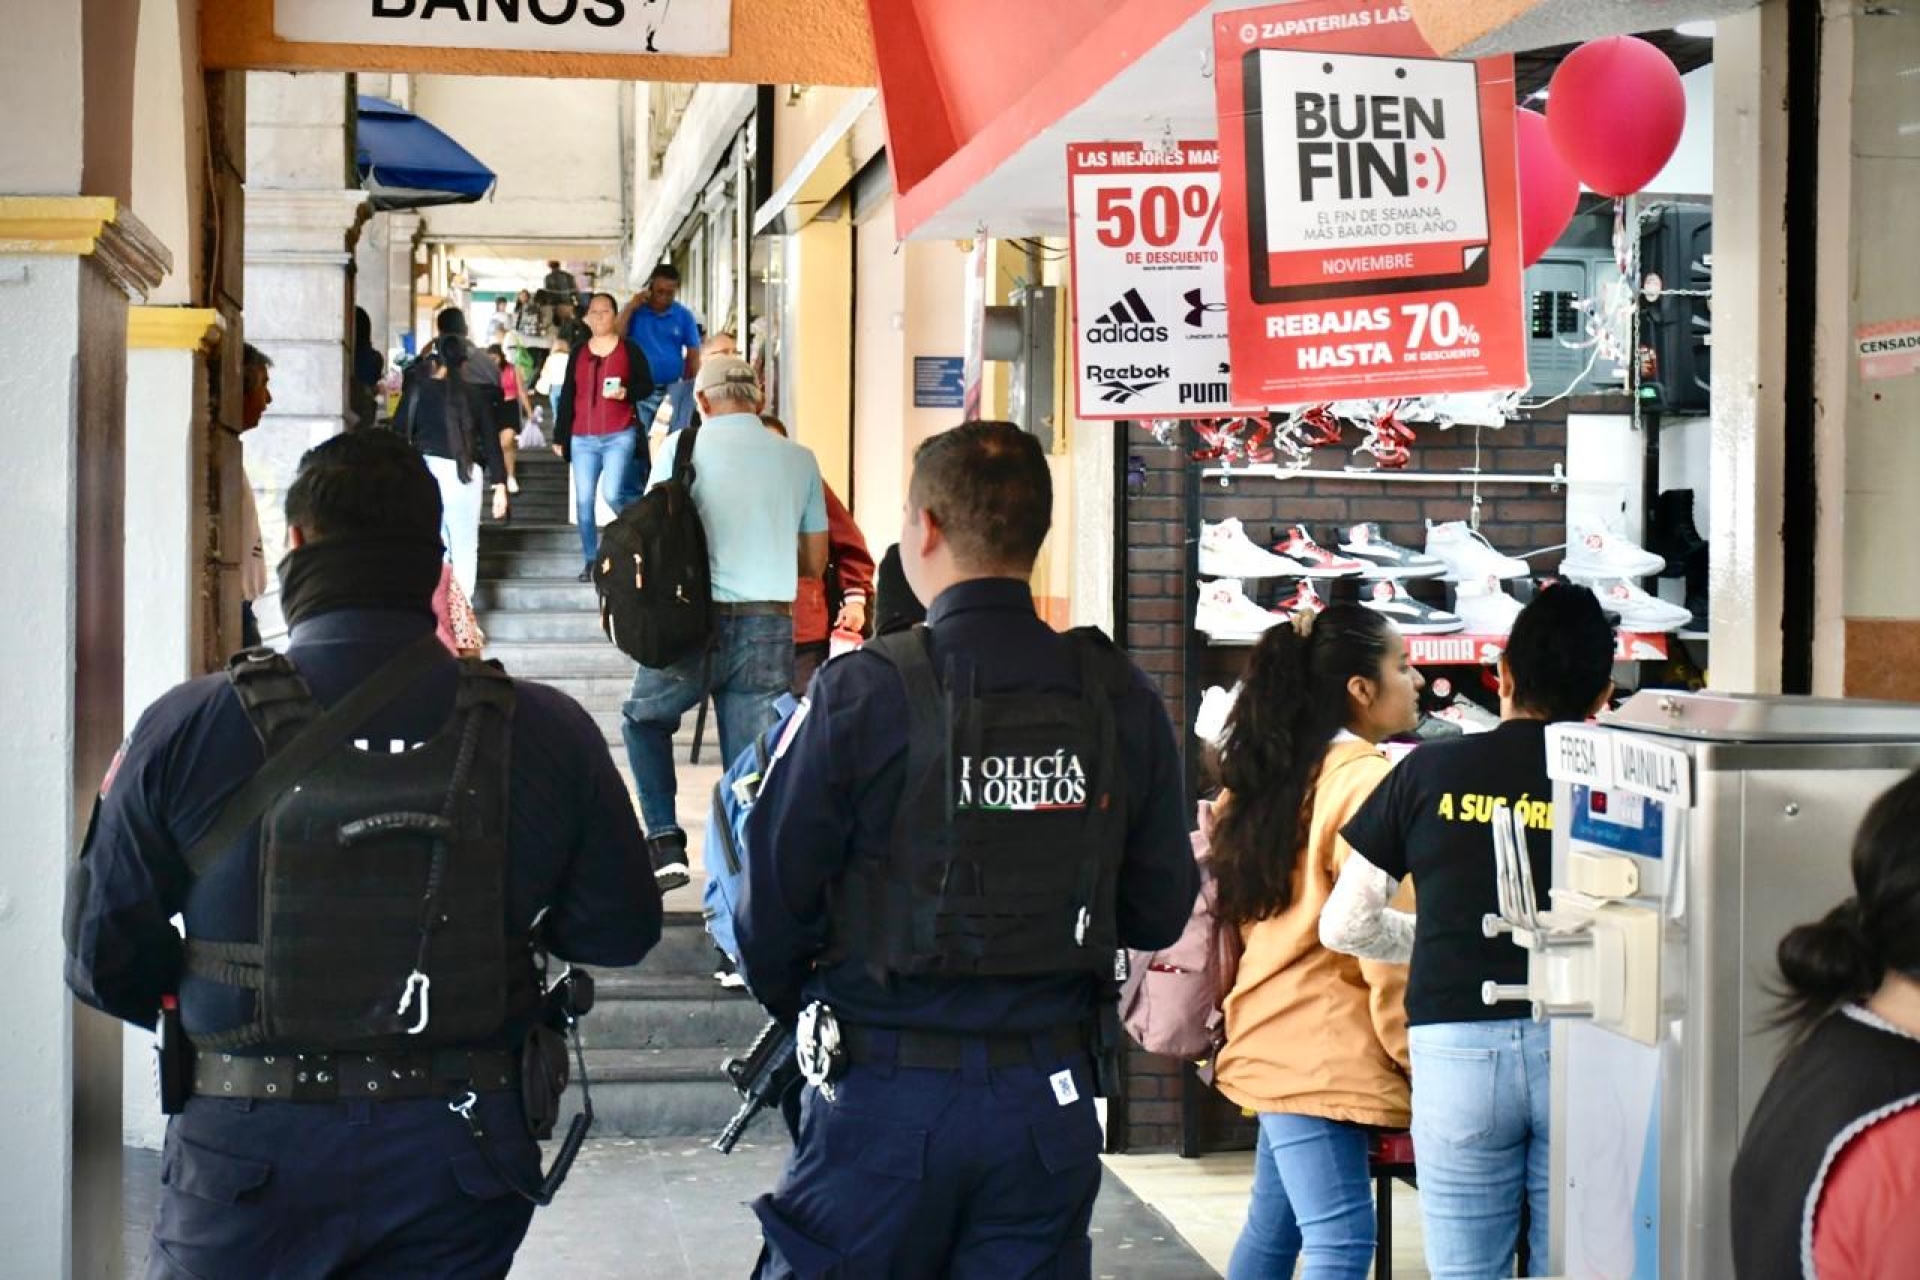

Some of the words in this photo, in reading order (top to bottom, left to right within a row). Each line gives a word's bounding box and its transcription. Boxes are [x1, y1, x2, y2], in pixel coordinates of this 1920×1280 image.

[1261, 11, 1371, 39] ZAPATERIAS
[1374, 5, 1411, 25] LAS
[1295, 92, 1446, 139] BUEN
[1078, 151, 1107, 168] LAS
[1112, 148, 1185, 166] MEJORES
[1317, 211, 1330, 225] EL
[1335, 209, 1356, 224] FIN
[1361, 207, 1377, 222] DE
[1382, 206, 1441, 220] SEMANA
[1338, 223, 1391, 239] BARATO
[1395, 221, 1419, 236] DEL
[1126, 252, 1141, 264] DE
[1145, 251, 1218, 264] DESCUENTO
[1323, 253, 1414, 275] NOVIEMBRE
[1086, 323, 1168, 343] adidas
[1266, 308, 1391, 338] REBAJAS
[1401, 301, 1480, 349] 70%
[1297, 342, 1392, 369] HASTA
[1420, 348, 1480, 361] DESCUENTO
[1086, 364, 1170, 382] Reebok
[1179, 383, 1230, 404] PUM
[1411, 639, 1474, 662] PUMA
[1561, 735, 1597, 777] FRESA
[1620, 743, 1678, 795] VAINILLA
[1438, 793, 1454, 820] A
